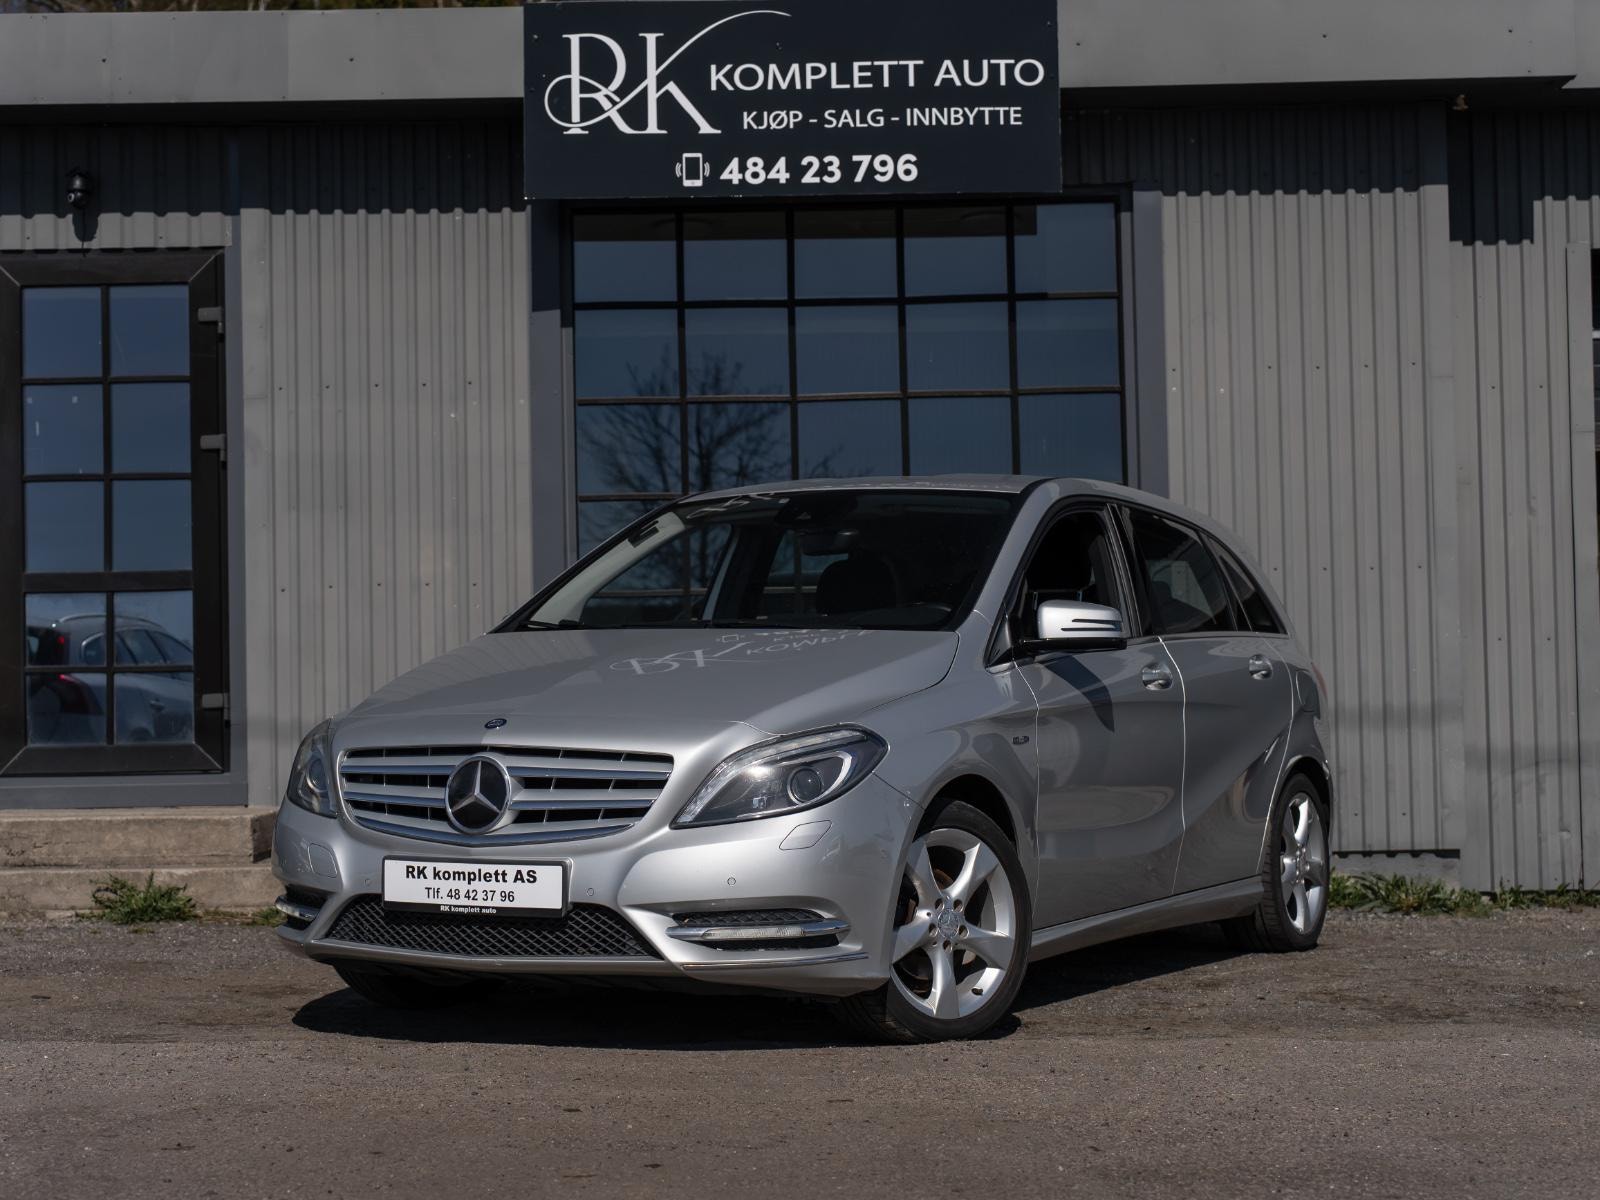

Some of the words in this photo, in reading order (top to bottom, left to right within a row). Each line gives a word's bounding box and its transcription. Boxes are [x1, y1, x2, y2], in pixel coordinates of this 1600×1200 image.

[544, 10, 791, 135] RK
[710, 60, 925, 91] KOMPLETT
[933, 58, 1045, 87] AUTO
[742, 109, 803, 130] KJØP
[823, 108, 885, 129] SALG
[906, 107, 1023, 127] INNBYTTE
[719, 157, 790, 185] 484
[800, 155, 842, 184] 23
[852, 153, 919, 183] 796
[405, 865, 428, 880] RK
[432, 866, 508, 885] komplett
[513, 869, 537, 884] AS
[424, 887, 444, 900] Tlf.
[446, 888, 461, 901] 48
[463, 889, 479, 901] 42
[481, 890, 497, 902] 37
[499, 890, 515, 903] 96
[440, 904, 450, 912] RK
[451, 905, 480, 914] komplett
